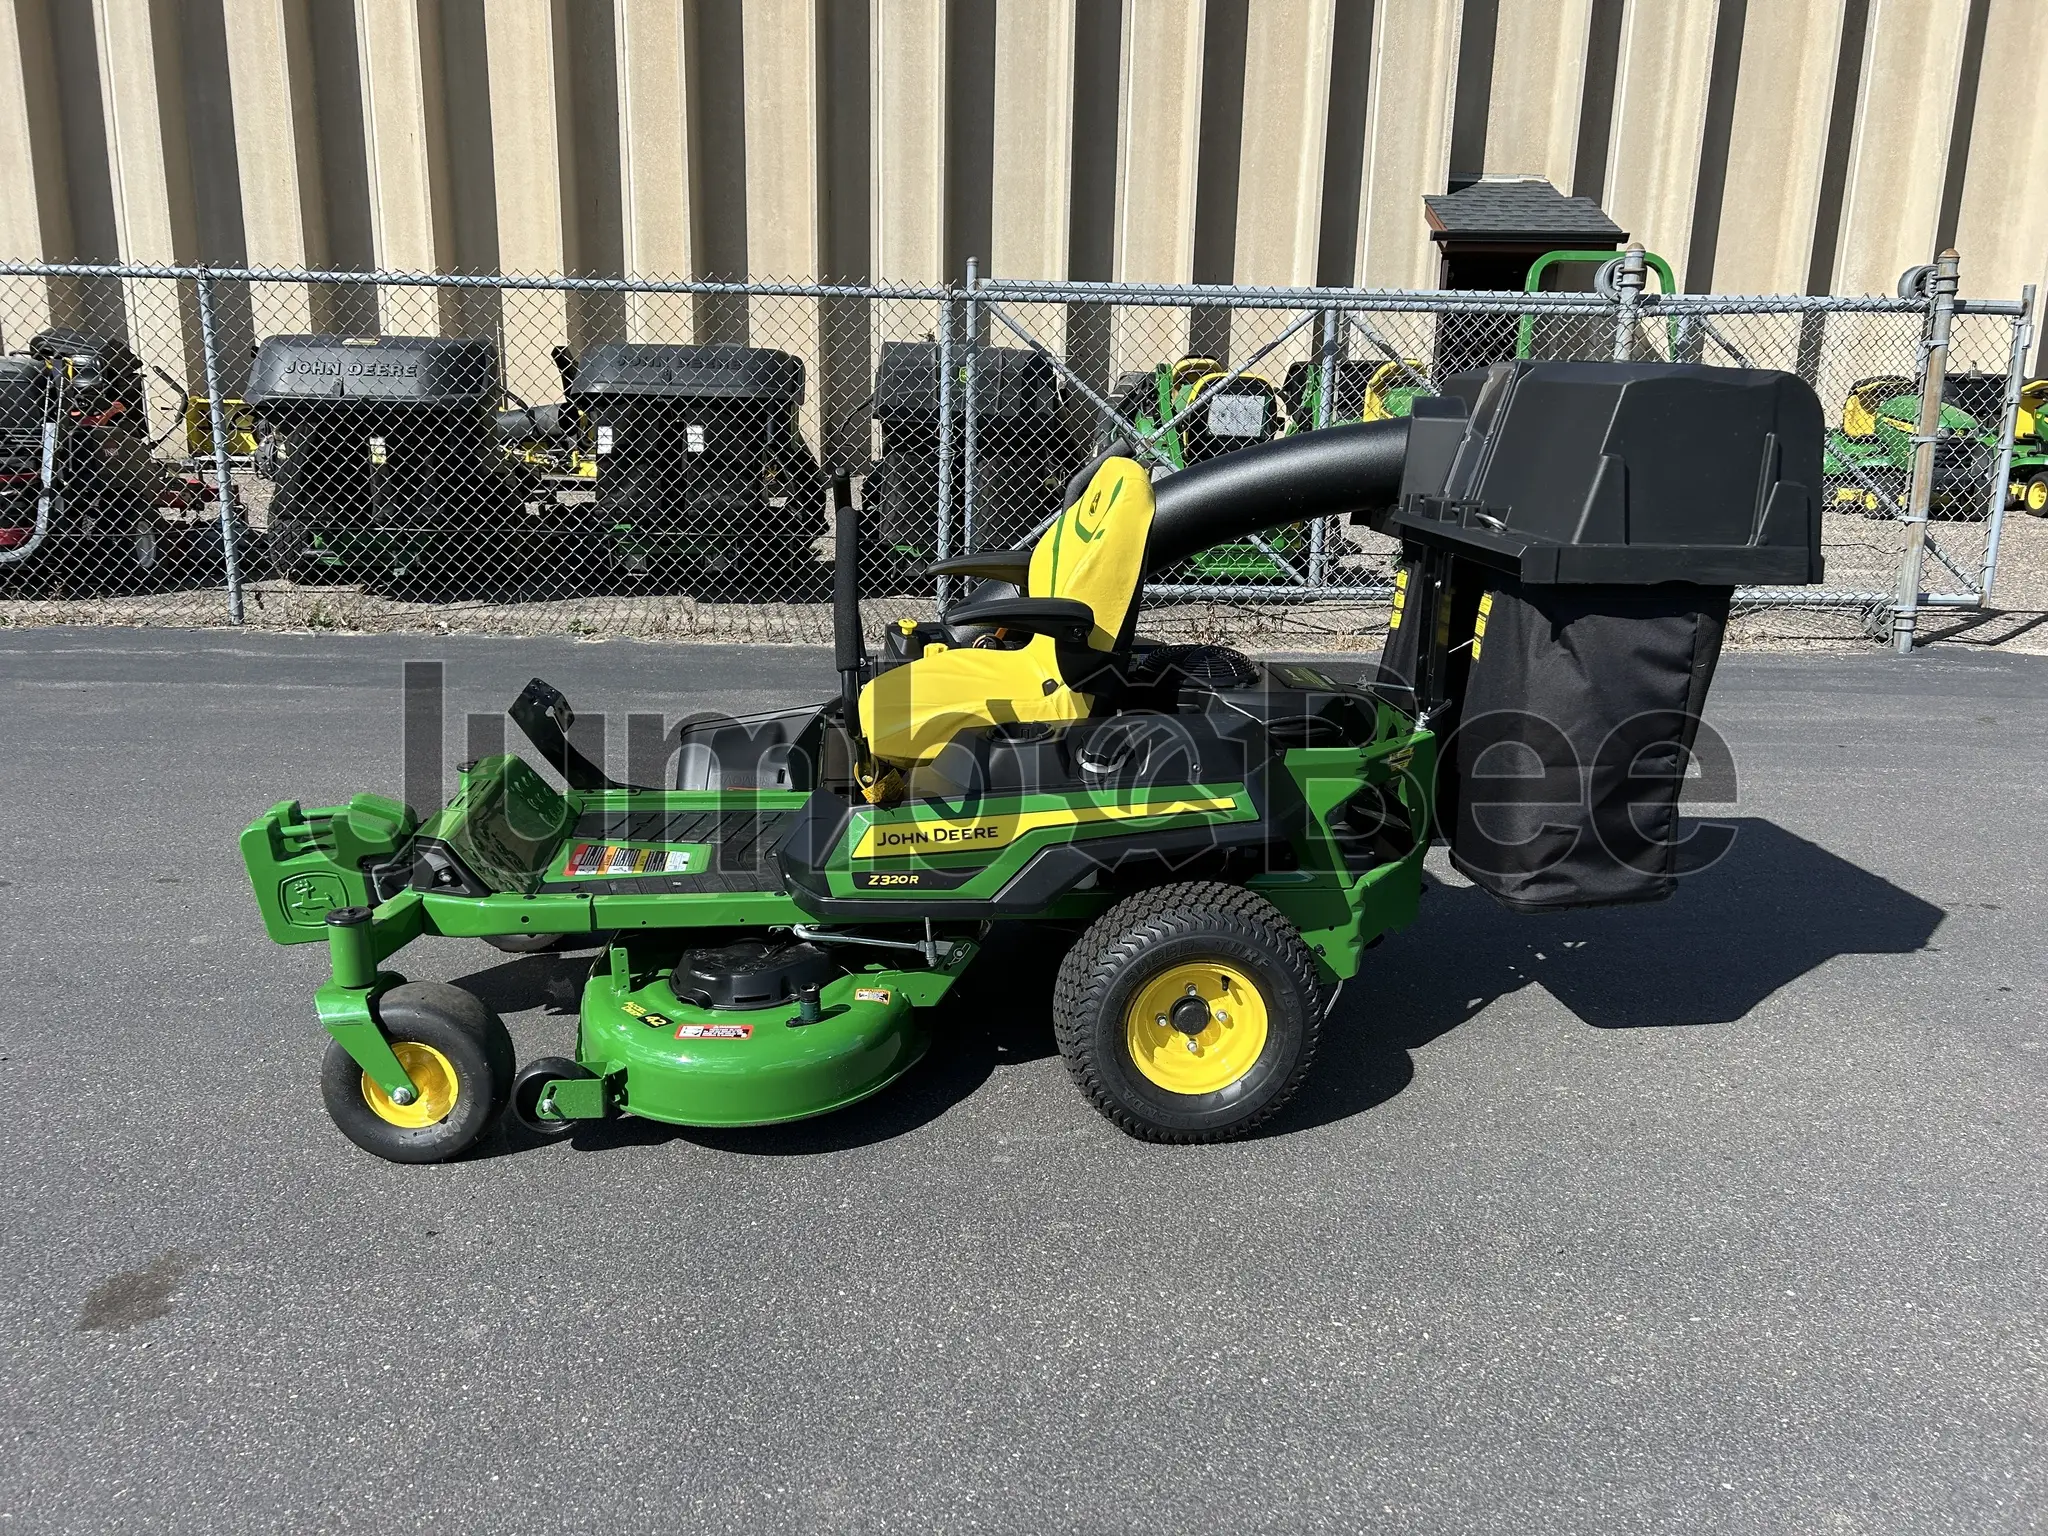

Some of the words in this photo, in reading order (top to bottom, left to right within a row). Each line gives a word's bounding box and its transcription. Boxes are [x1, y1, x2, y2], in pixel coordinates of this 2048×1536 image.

[284, 361, 341, 376] JOHN
[348, 363, 418, 378] DEERE
[877, 831, 929, 847] JOHN
[934, 826, 999, 842] DEERE
[867, 875, 919, 886] Z320R
[1215, 940, 1273, 968] TURF
[645, 1016, 667, 1027] 42
